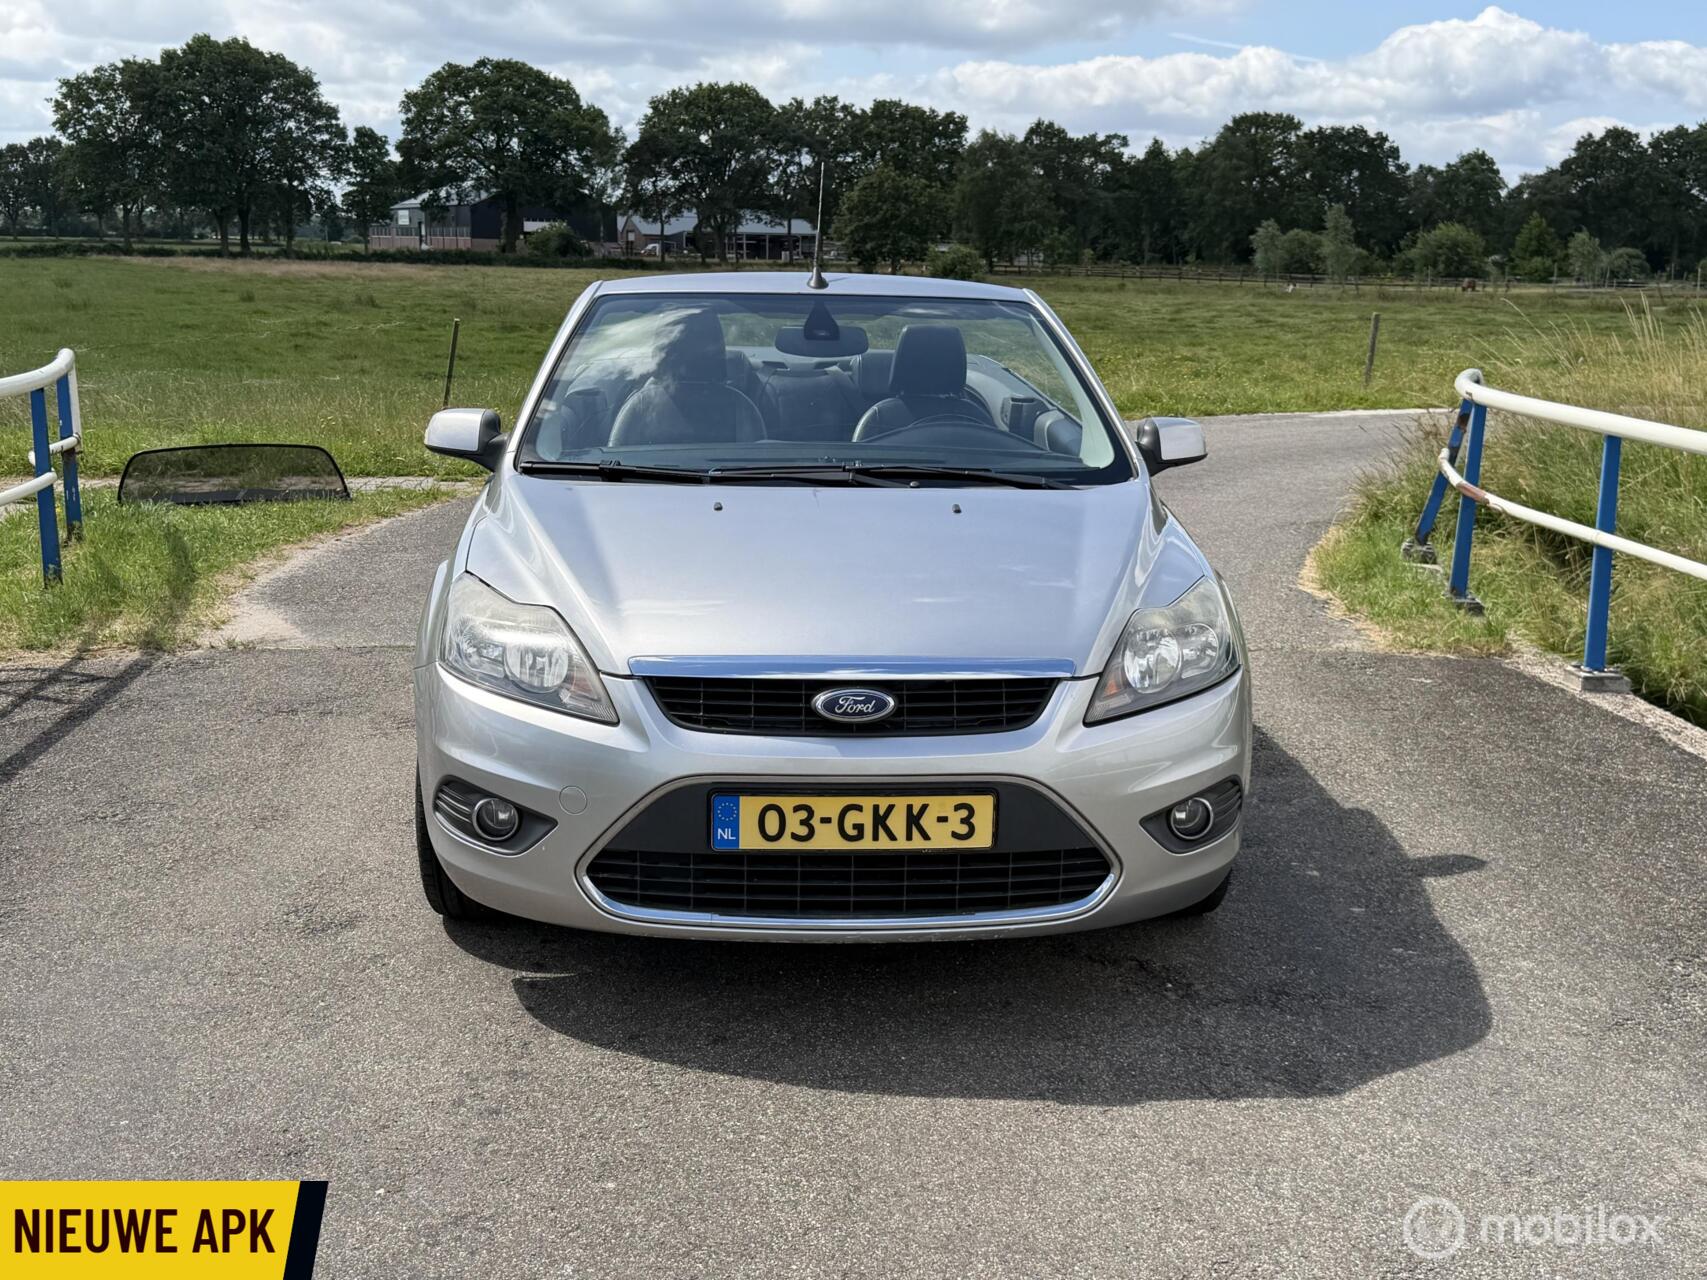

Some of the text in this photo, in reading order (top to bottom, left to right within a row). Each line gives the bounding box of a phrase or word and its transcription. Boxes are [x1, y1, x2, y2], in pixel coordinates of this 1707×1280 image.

[834, 696, 876, 714] Ford
[757, 802, 976, 842] 03-GKK-3
[717, 828, 736, 840] NL
